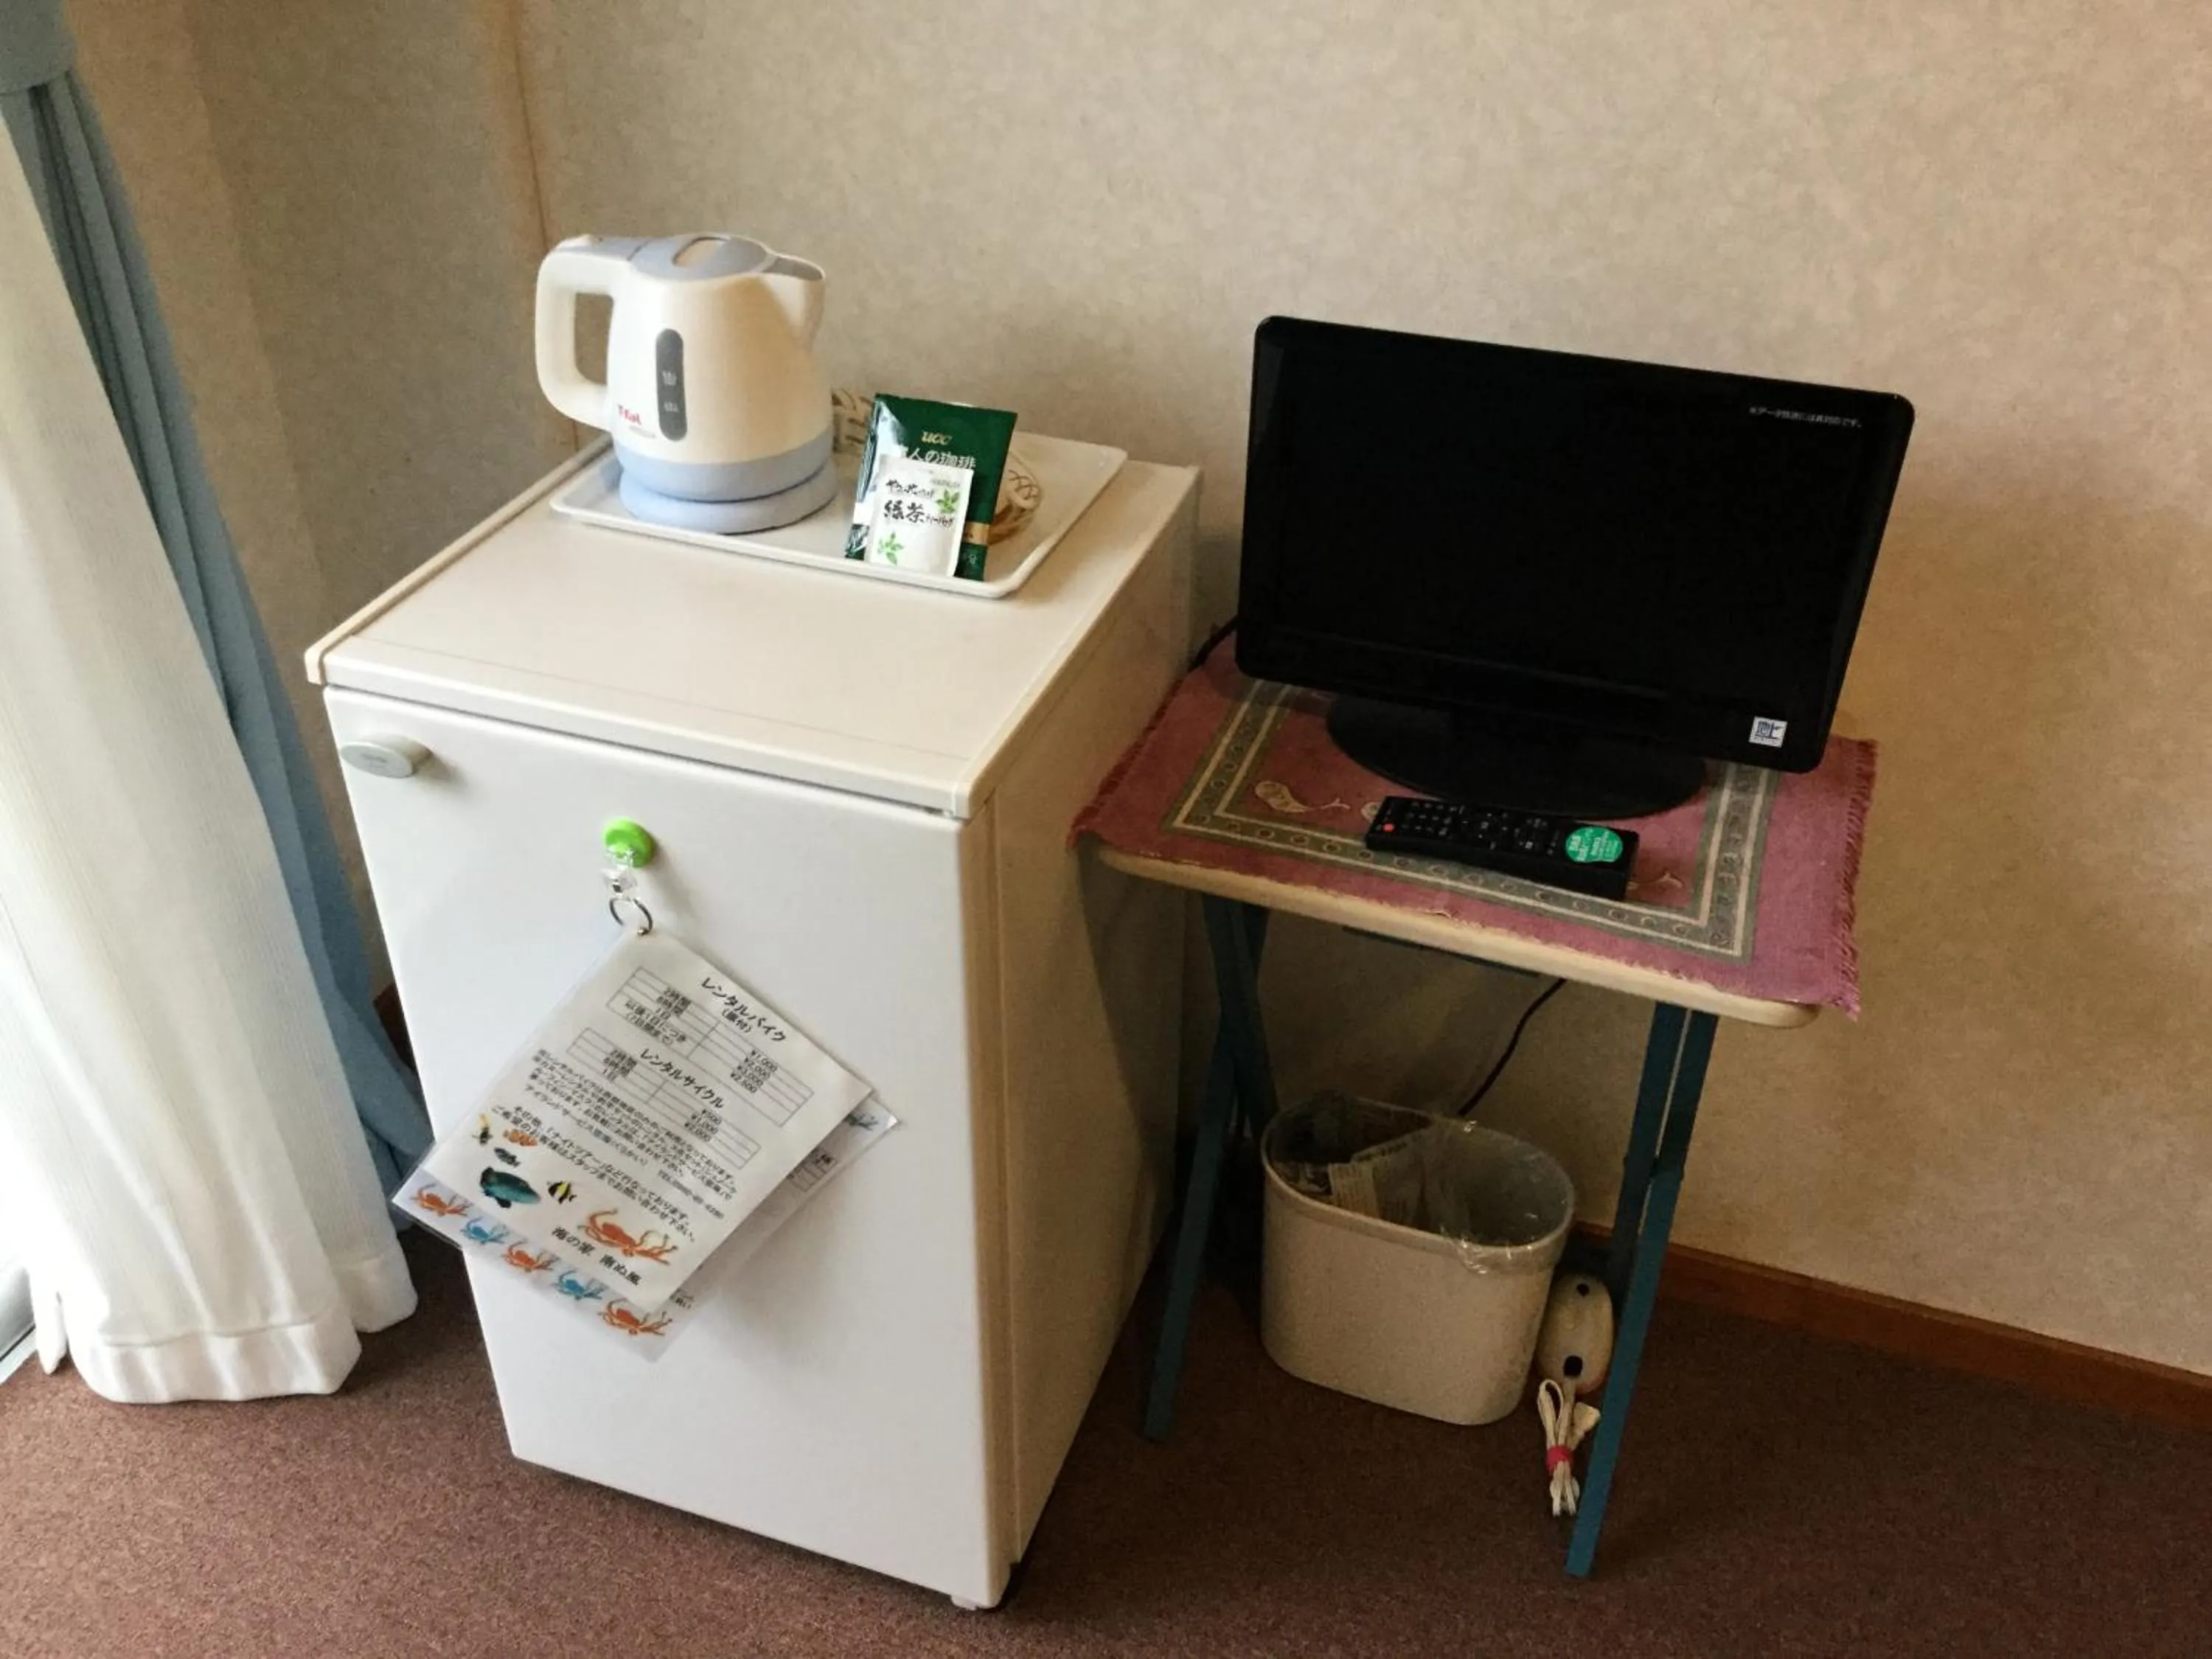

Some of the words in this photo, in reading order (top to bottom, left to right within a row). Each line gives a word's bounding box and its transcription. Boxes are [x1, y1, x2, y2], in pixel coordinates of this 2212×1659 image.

[700, 977, 786, 1043] レンタルバイク
[640, 1047, 726, 1109] レンタルサイクル
